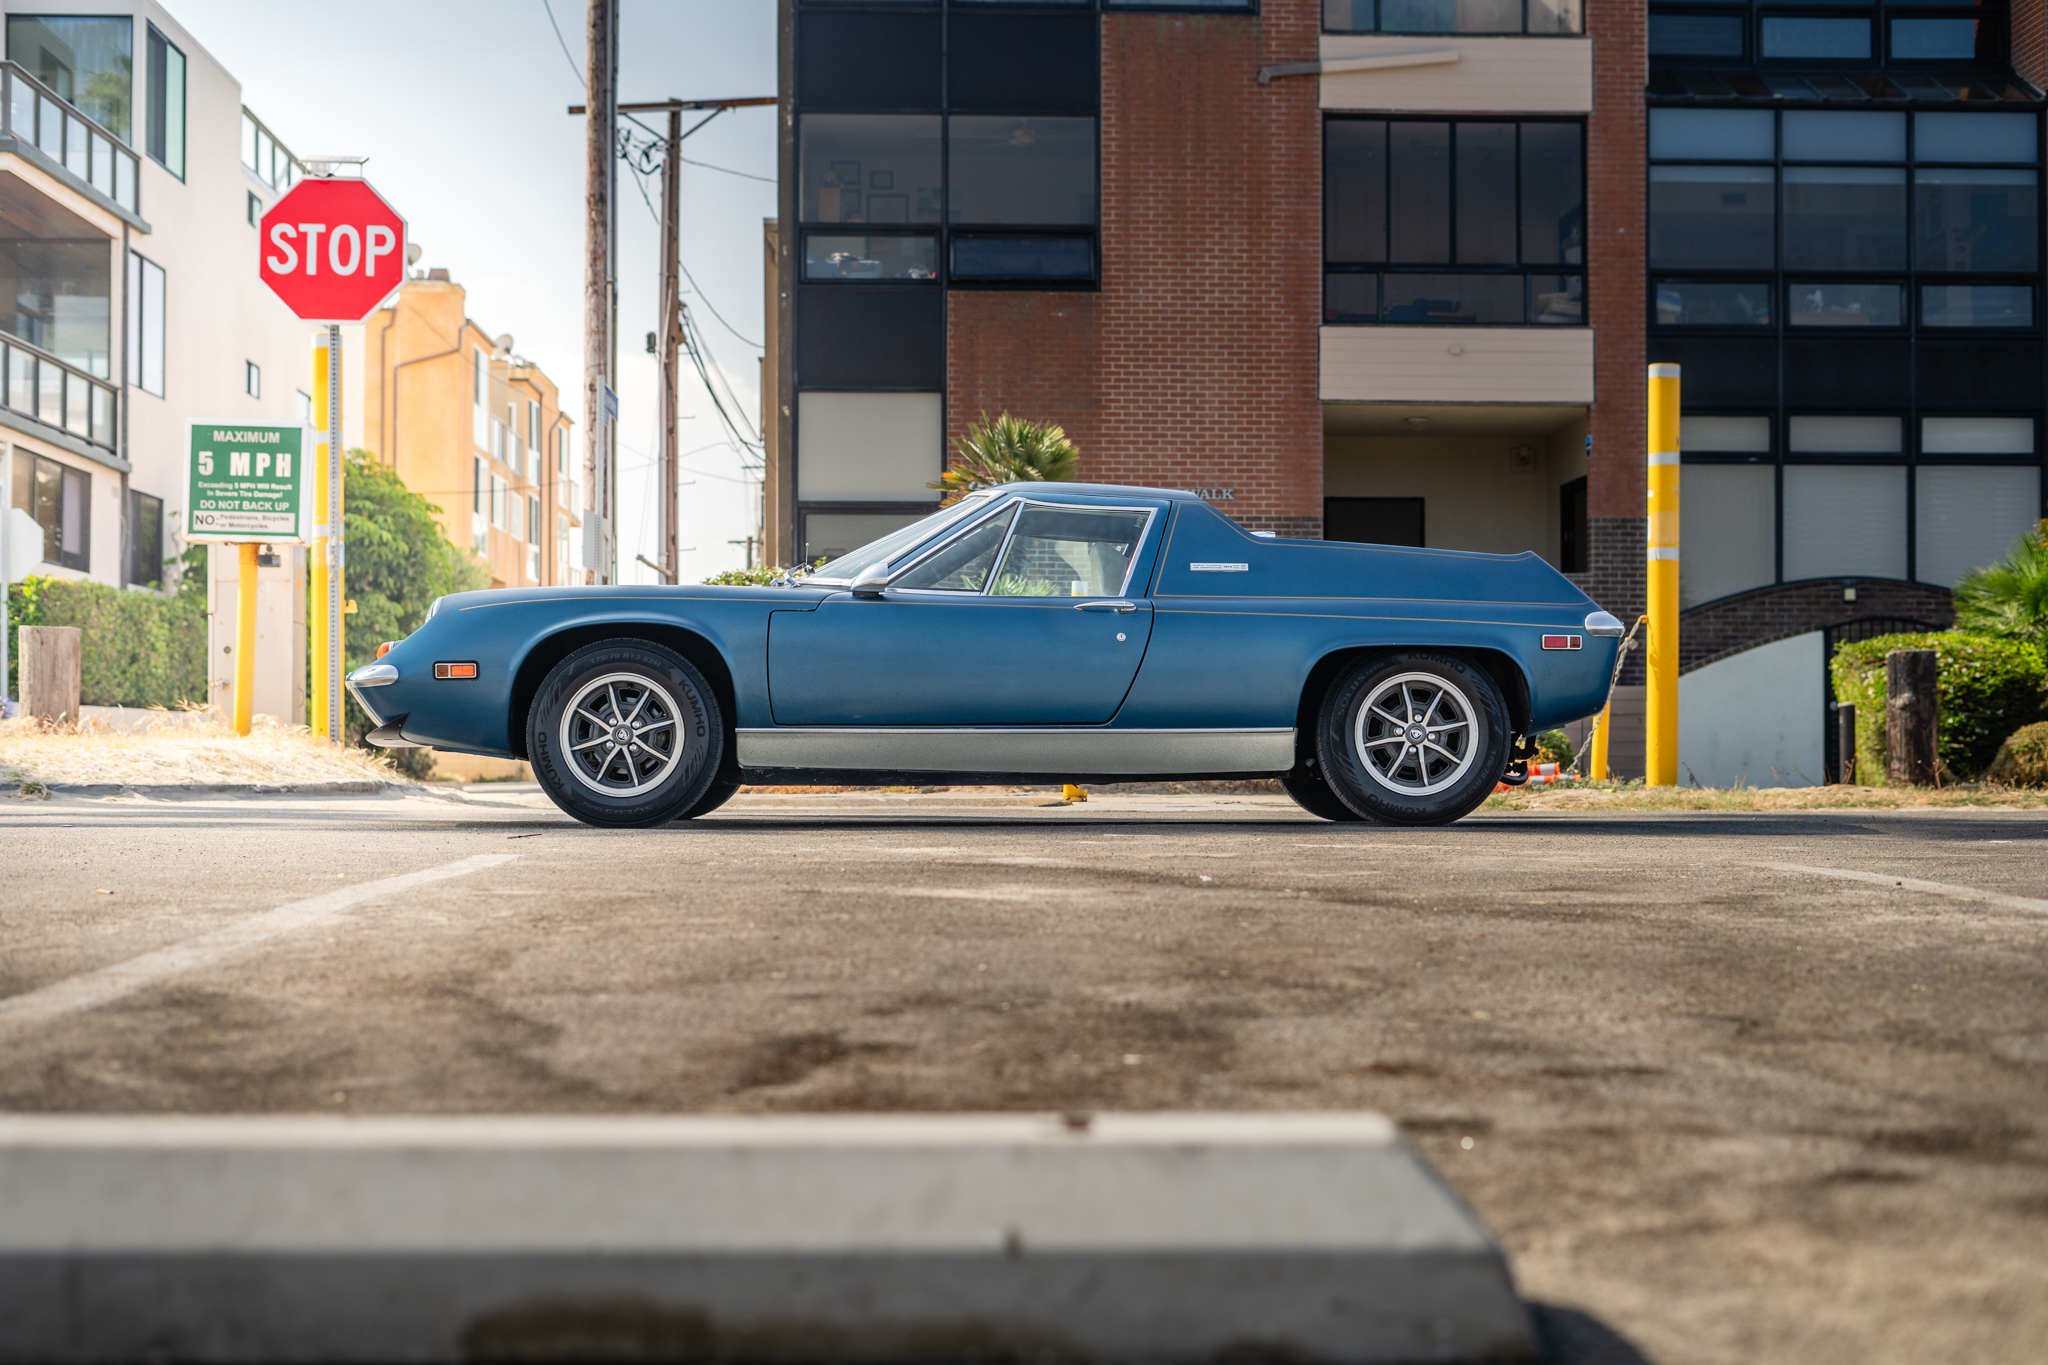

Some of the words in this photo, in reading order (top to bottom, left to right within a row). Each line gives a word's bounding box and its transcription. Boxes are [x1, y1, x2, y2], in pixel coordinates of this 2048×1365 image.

[267, 222, 396, 277] STOP
[213, 430, 280, 443] MAXIMUM
[198, 451, 214, 476] 5
[230, 452, 291, 477] MPH
[198, 481, 233, 490] Exceeding
[253, 491, 283, 500] Damage!
[200, 500, 216, 509] DO
[218, 500, 241, 510] NOT
[242, 501, 273, 511] BACK
[275, 502, 290, 511] UP
[195, 514, 219, 526] NO:
[262, 514, 290, 522] Bicycles
[590, 652, 620, 665] 175/70
[678, 679, 706, 738] KUMHO
[538, 731, 565, 789] KUMHO
